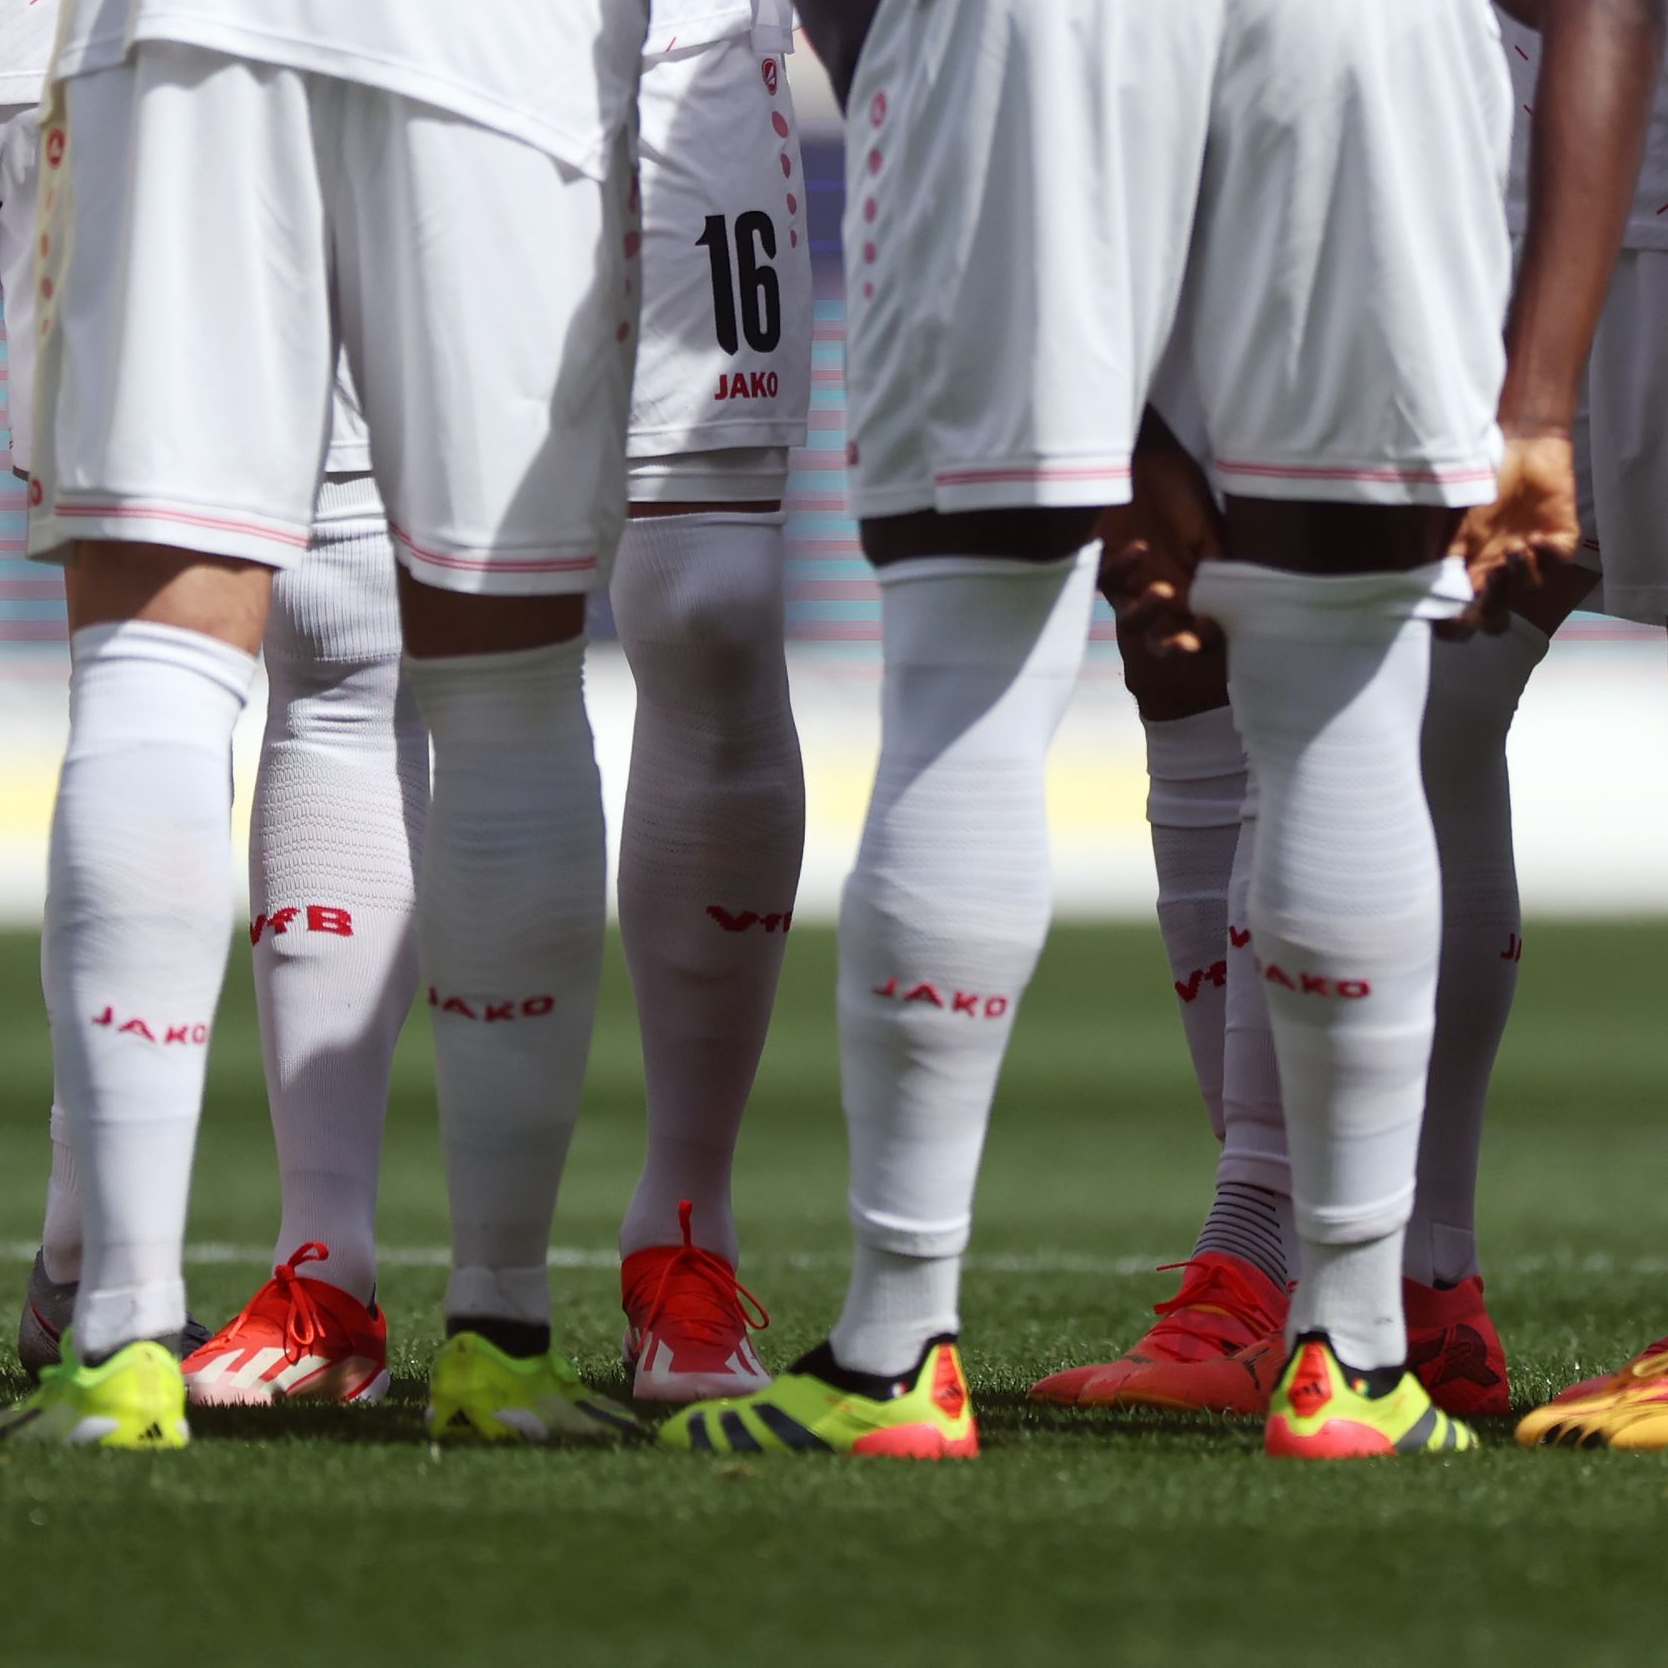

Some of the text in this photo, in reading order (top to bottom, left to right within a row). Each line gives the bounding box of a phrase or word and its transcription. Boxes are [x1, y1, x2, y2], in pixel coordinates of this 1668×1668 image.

[695, 211, 781, 356] 16
[714, 371, 778, 400] JAKO
[872, 976, 1007, 1018] JAKO
[92, 1006, 209, 1044] JAKO
